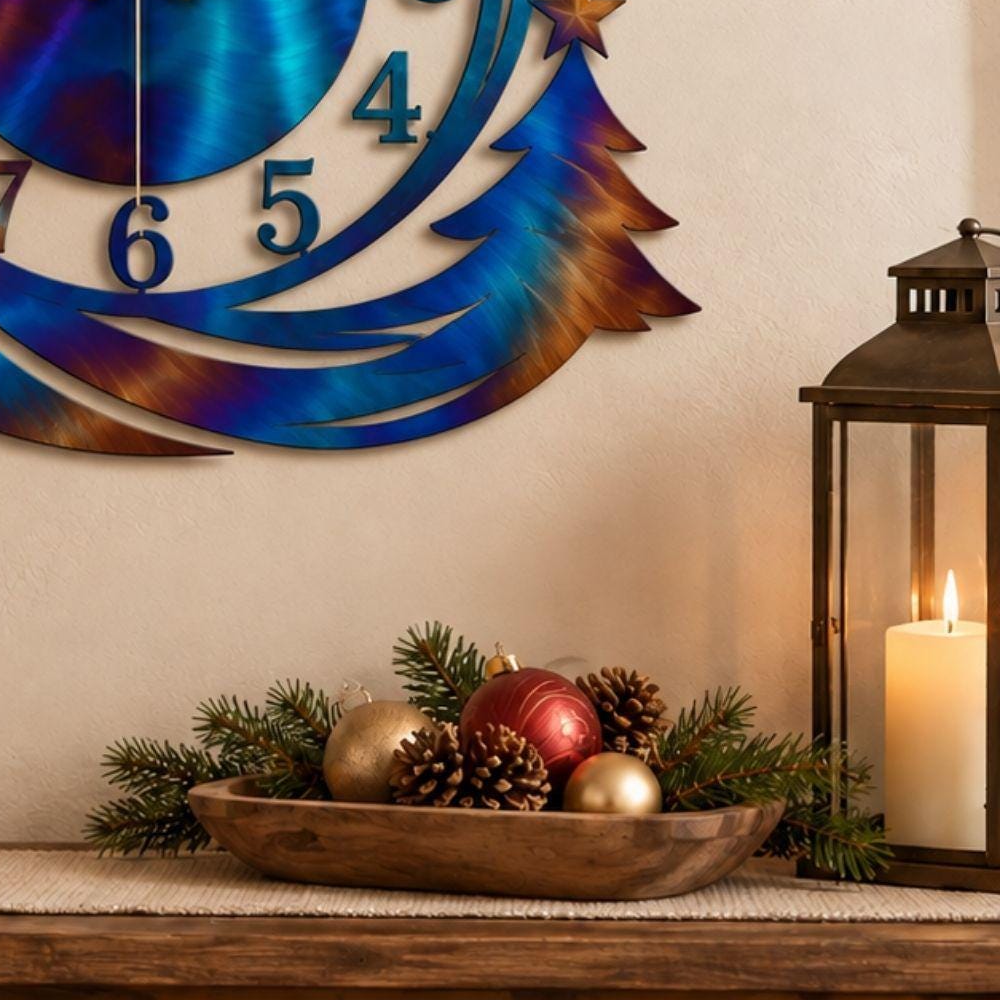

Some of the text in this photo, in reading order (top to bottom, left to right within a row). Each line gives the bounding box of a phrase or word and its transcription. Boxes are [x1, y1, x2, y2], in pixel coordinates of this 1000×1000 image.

[352, 51, 421, 144] 4
[108, 195, 173, 290] 6
[256, 157, 320, 255] 5
